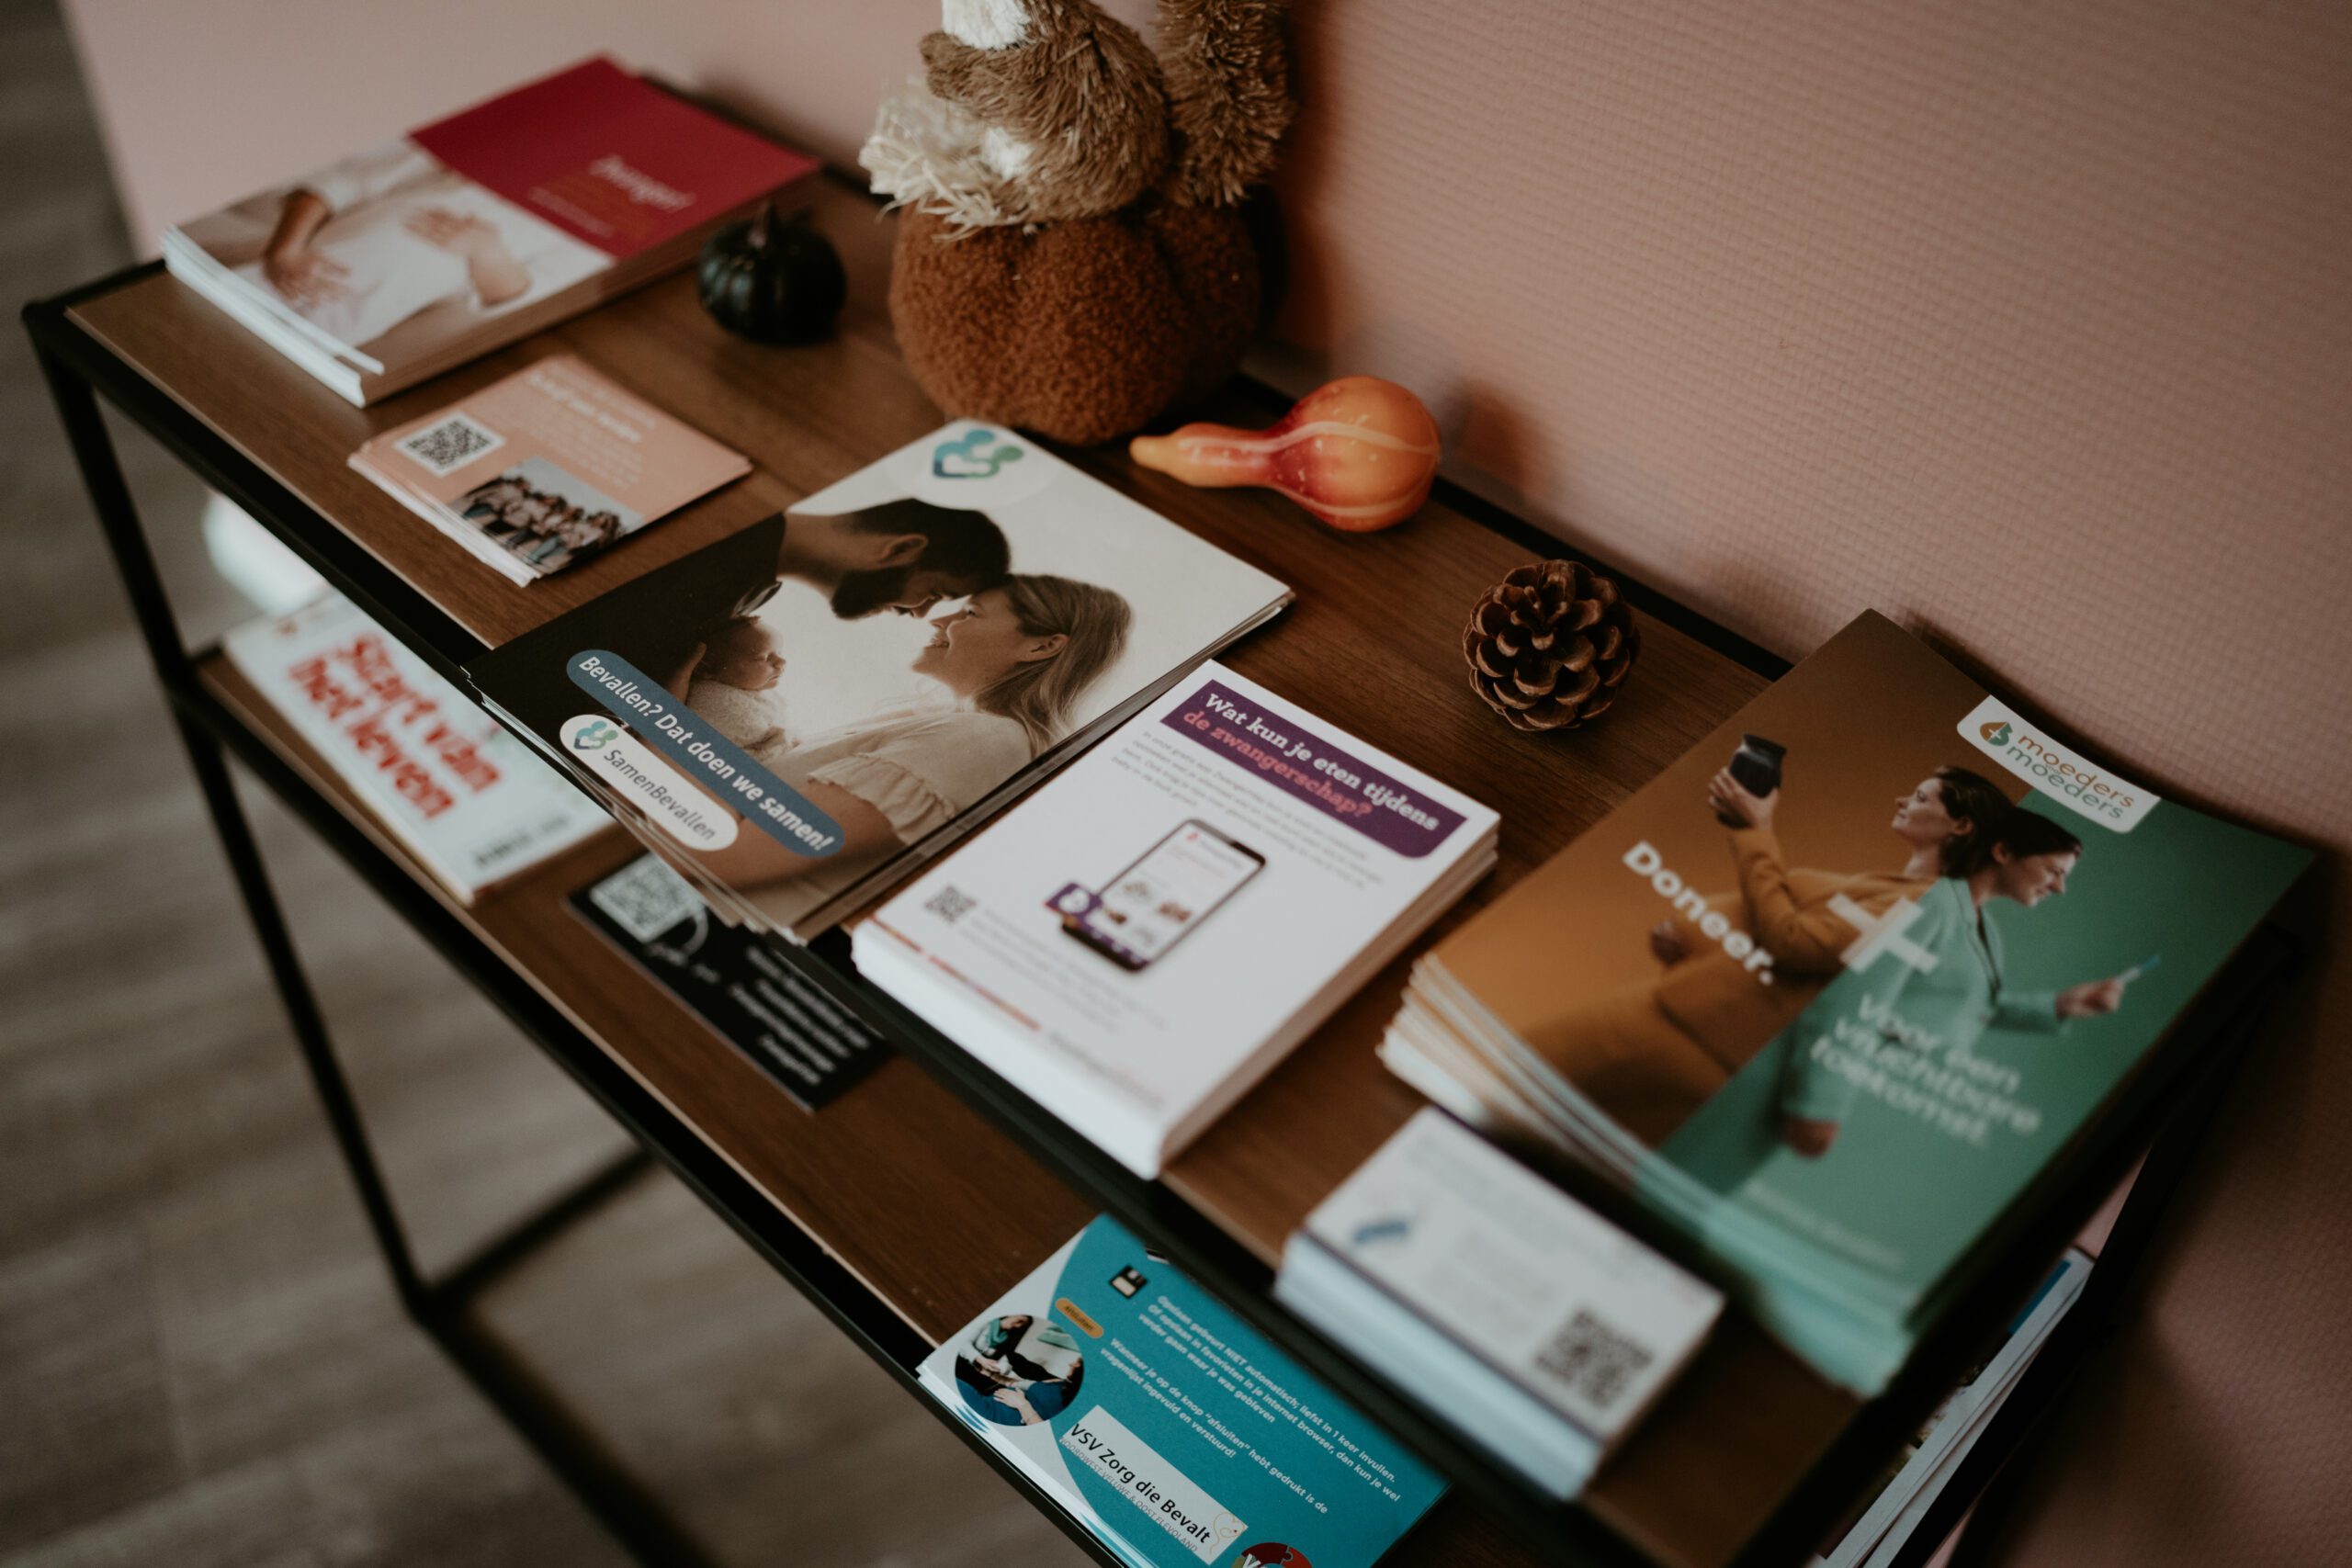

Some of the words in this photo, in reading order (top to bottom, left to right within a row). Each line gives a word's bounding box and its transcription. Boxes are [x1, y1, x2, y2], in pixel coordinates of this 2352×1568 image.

[288, 653, 364, 721] het
[347, 711, 455, 819] leven
[352, 633, 439, 725] Start
[423, 721, 501, 794] van
[579, 656, 663, 716] Bevallen?
[655, 714, 693, 744] Dat
[687, 737, 736, 780] doen
[732, 775, 763, 801] we
[759, 793, 835, 852] samen!
[1183, 710, 1210, 731] de
[1209, 727, 1373, 818] zwangerschap?
[1205, 694, 1247, 726] Wat
[1246, 716, 1288, 749] kun
[1283, 741, 1313, 763] je
[1313, 755, 1361, 790] eten
[1363, 781, 1440, 830] tijdens
[2018, 735, 2135, 808] moeders
[604, 750, 716, 840] SamenBevallen
[2007, 746, 2124, 819] moeders
[1623, 841, 1774, 986] Doneer.
[1097, 1345, 1146, 1386] vragenlijst
[1140, 1379, 1182, 1415] ingevuld
[1177, 1408, 1193, 1424] en
[1189, 1418, 1237, 1459] verstuurd!
[1107, 1337, 1150, 1372] Wanneer
[1144, 1366, 1158, 1381] je
[1154, 1375, 1170, 1391] op
[1167, 1383, 1183, 1399] de
[1178, 1393, 1205, 1417] knop
[1248, 1448, 1272, 1469] hebt
[1267, 1463, 1307, 1498] gedrukt
[1304, 1492, 1317, 1505] is
[1312, 1498, 1330, 1516] de
[1136, 1311, 1168, 1338] verder
[1163, 1334, 1188, 1356] gaan
[1185, 1350, 1209, 1371] waar
[1204, 1366, 1219, 1380] je
[1216, 1374, 1236, 1393] was
[1232, 1387, 1276, 1425] gebleven
[1146, 1302, 1162, 1318] Of
[1157, 1312, 1194, 1343] opslaan
[1190, 1337, 1204, 1349] in
[1199, 1344, 1246, 1383] favorieten
[1242, 1377, 1255, 1390] in
[1250, 1384, 1265, 1399] je
[1261, 1393, 1298, 1424] internet
[1295, 1418, 1337, 1455] browser,
[1334, 1449, 1355, 1468] dan
[1352, 1462, 1373, 1482] kun
[1368, 1475, 1384, 1491] je
[1381, 1484, 1401, 1503] wel
[1188, 1319, 1227, 1352] gebeurt
[1222, 1345, 1248, 1368] NIET
[1243, 1361, 1301, 1409] automatisch;
[1298, 1404, 1324, 1426] liefst
[1321, 1421, 1334, 1434] in
[1331, 1428, 1340, 1438] 1
[1337, 1433, 1361, 1454] keer
[1357, 1449, 1397, 1483] invullen.
[1071, 1424, 1102, 1450] VSV
[1099, 1450, 1136, 1484] Zorg
[1136, 1482, 1160, 1503] die
[1160, 1499, 1210, 1543] Bevalt
[1136, 1499, 1156, 1517] OOST
[1156, 1515, 1198, 1552] FLEVOLAND
